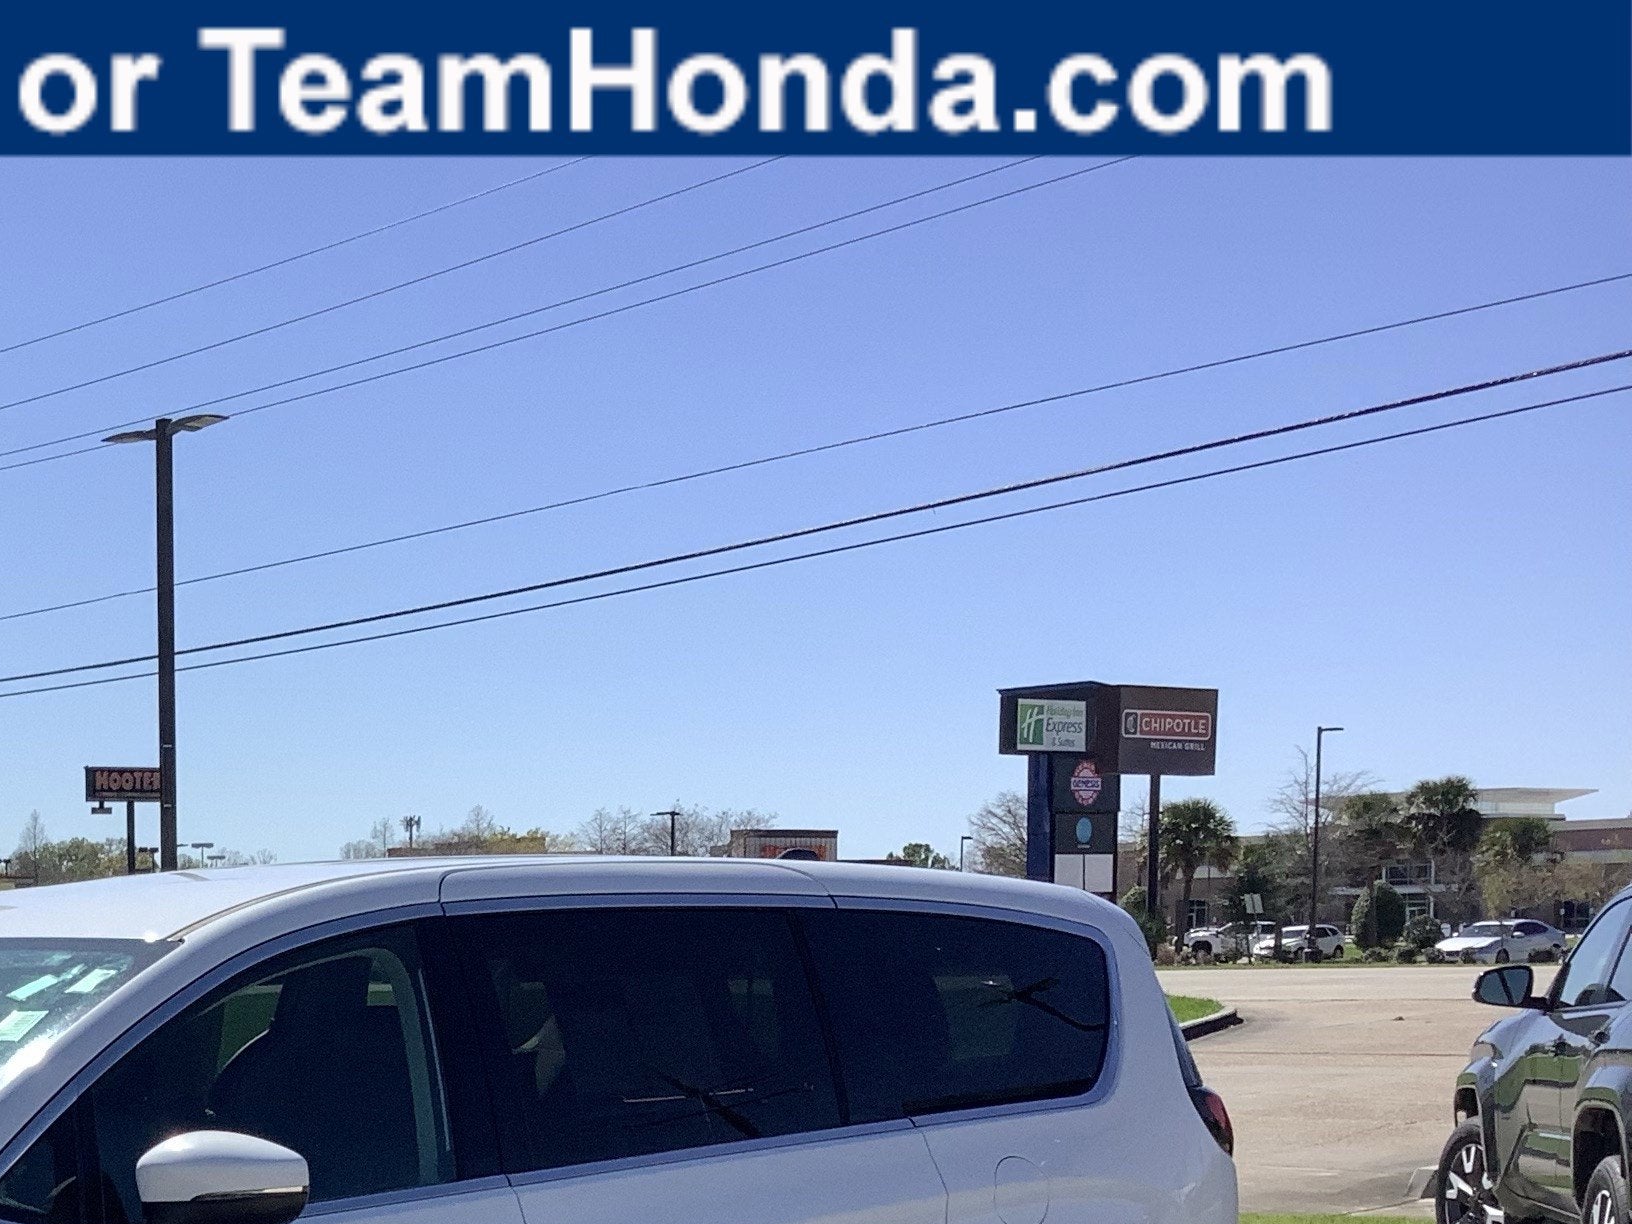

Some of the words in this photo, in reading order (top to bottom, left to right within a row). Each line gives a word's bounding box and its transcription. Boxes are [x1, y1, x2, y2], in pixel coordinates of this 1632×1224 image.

[1046, 717, 1084, 735] Express
[1141, 717, 1207, 734] CHIPOTLE
[1150, 741, 1183, 750] MEXICAN
[95, 770, 161, 791] HOOTER
